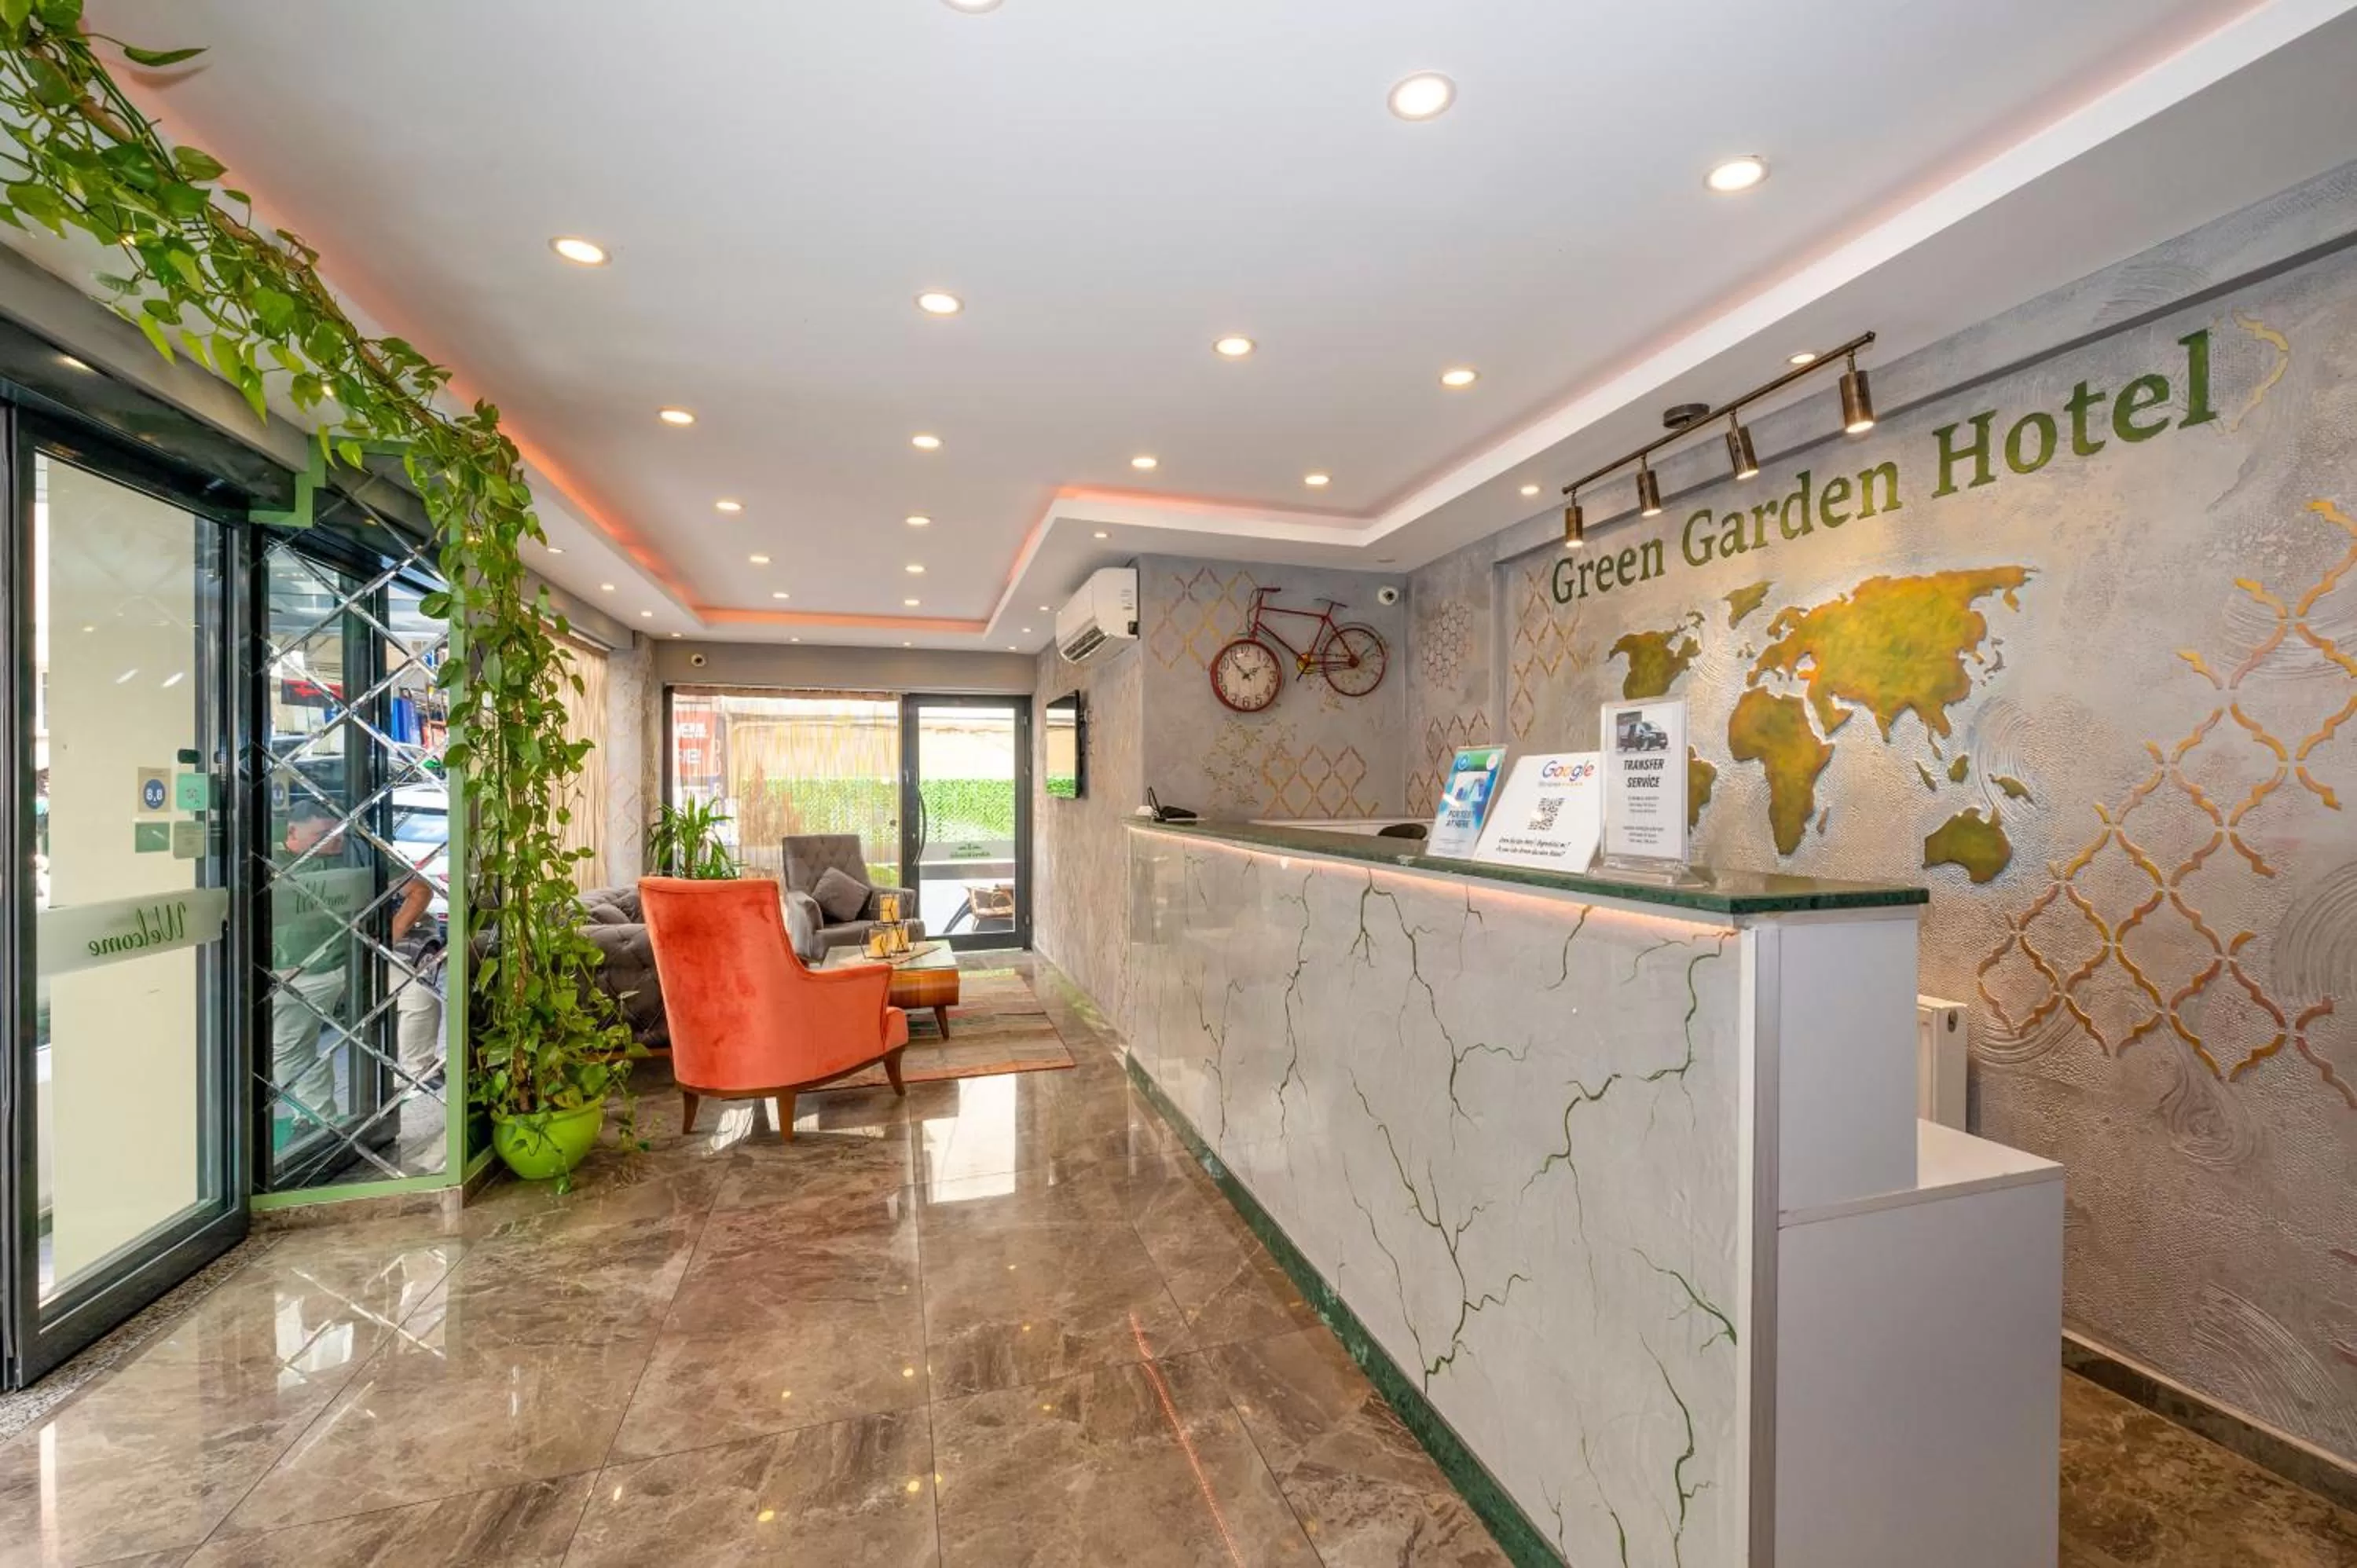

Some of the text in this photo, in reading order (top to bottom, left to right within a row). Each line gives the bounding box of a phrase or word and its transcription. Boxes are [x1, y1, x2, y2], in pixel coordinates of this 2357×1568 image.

[1552, 328, 2218, 604] Green Garden Hotel
[1220, 657, 1230, 670] 10
[1263, 655, 1270, 669] 2
[1269, 670, 1277, 683] 3
[1263, 684, 1270, 697] 4
[1242, 696, 1251, 708] 6
[1255, 694, 1263, 705] 5
[1542, 760, 1593, 781] Google
[1624, 758, 1664, 770] TRANSFER
